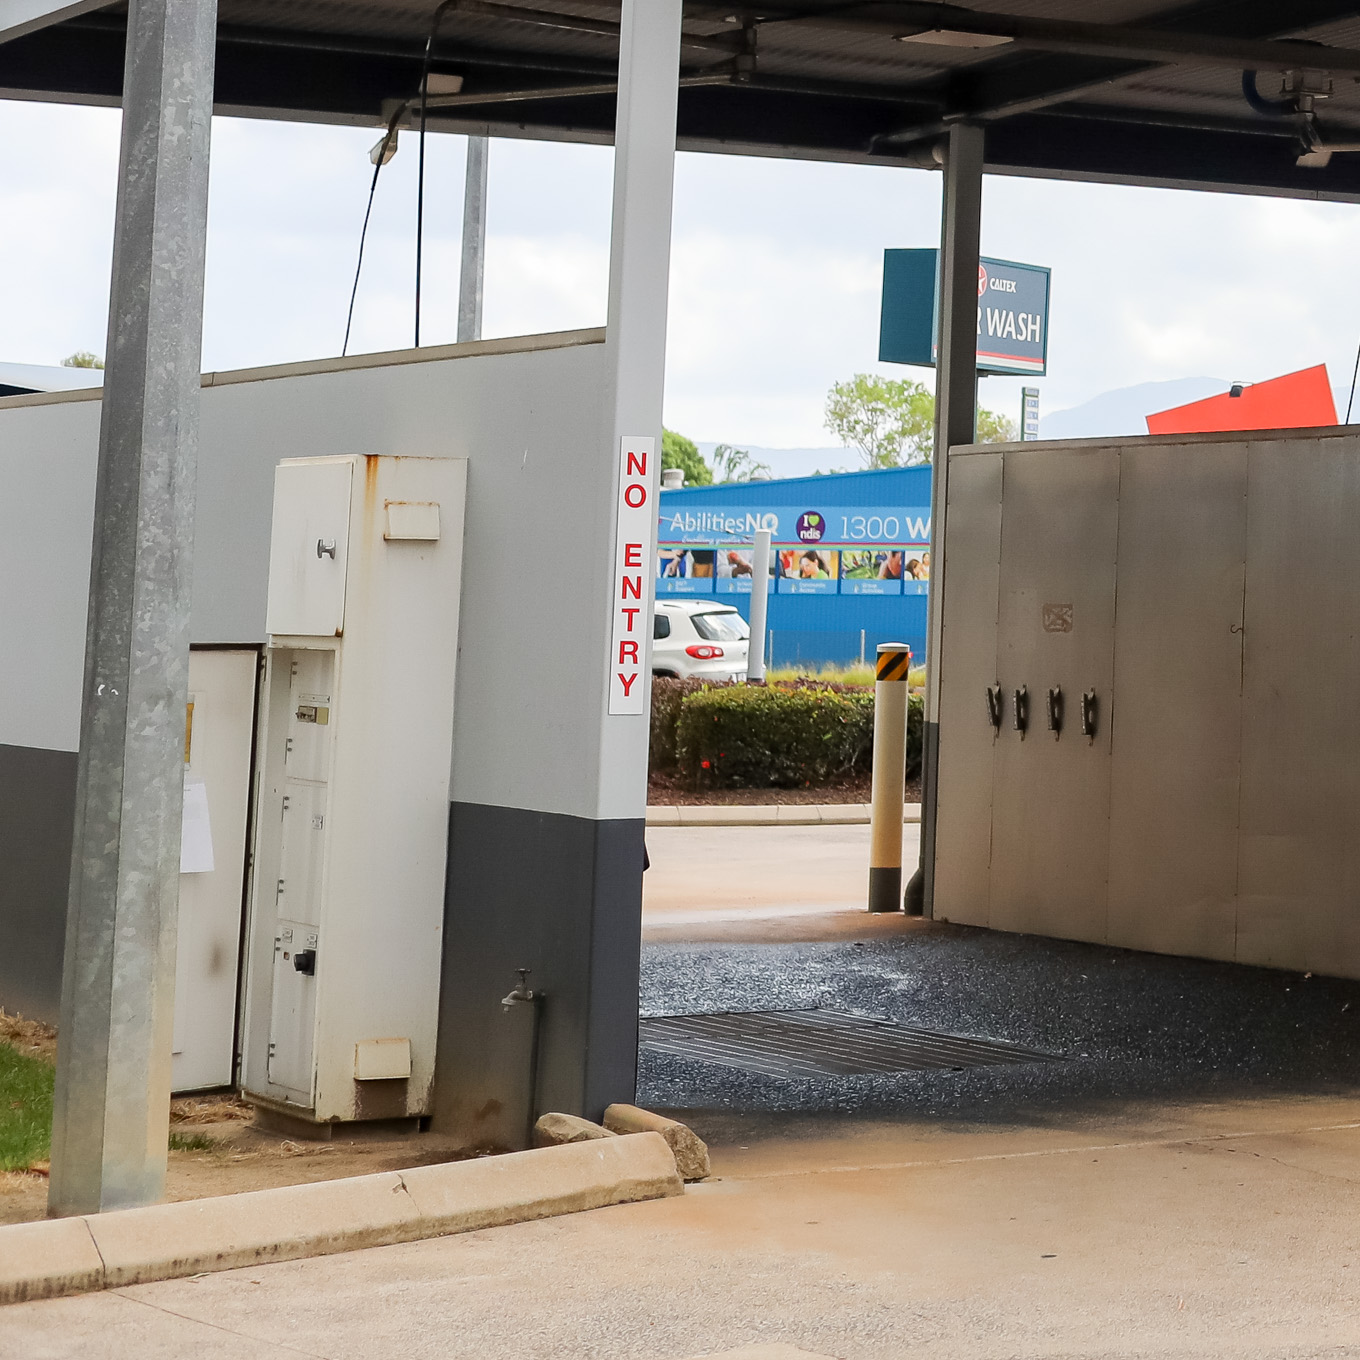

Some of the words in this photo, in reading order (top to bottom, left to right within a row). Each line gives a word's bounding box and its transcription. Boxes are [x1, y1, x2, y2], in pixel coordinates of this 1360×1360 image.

[989, 277, 1017, 293] CALTEX
[986, 307, 1041, 343] WASH
[624, 452, 647, 509] NO
[670, 512, 779, 536] AbilitiesNQ
[803, 514, 809, 527] I
[840, 516, 899, 539] 1300
[800, 528, 821, 540] ndis
[617, 543, 643, 697] ENTRY
